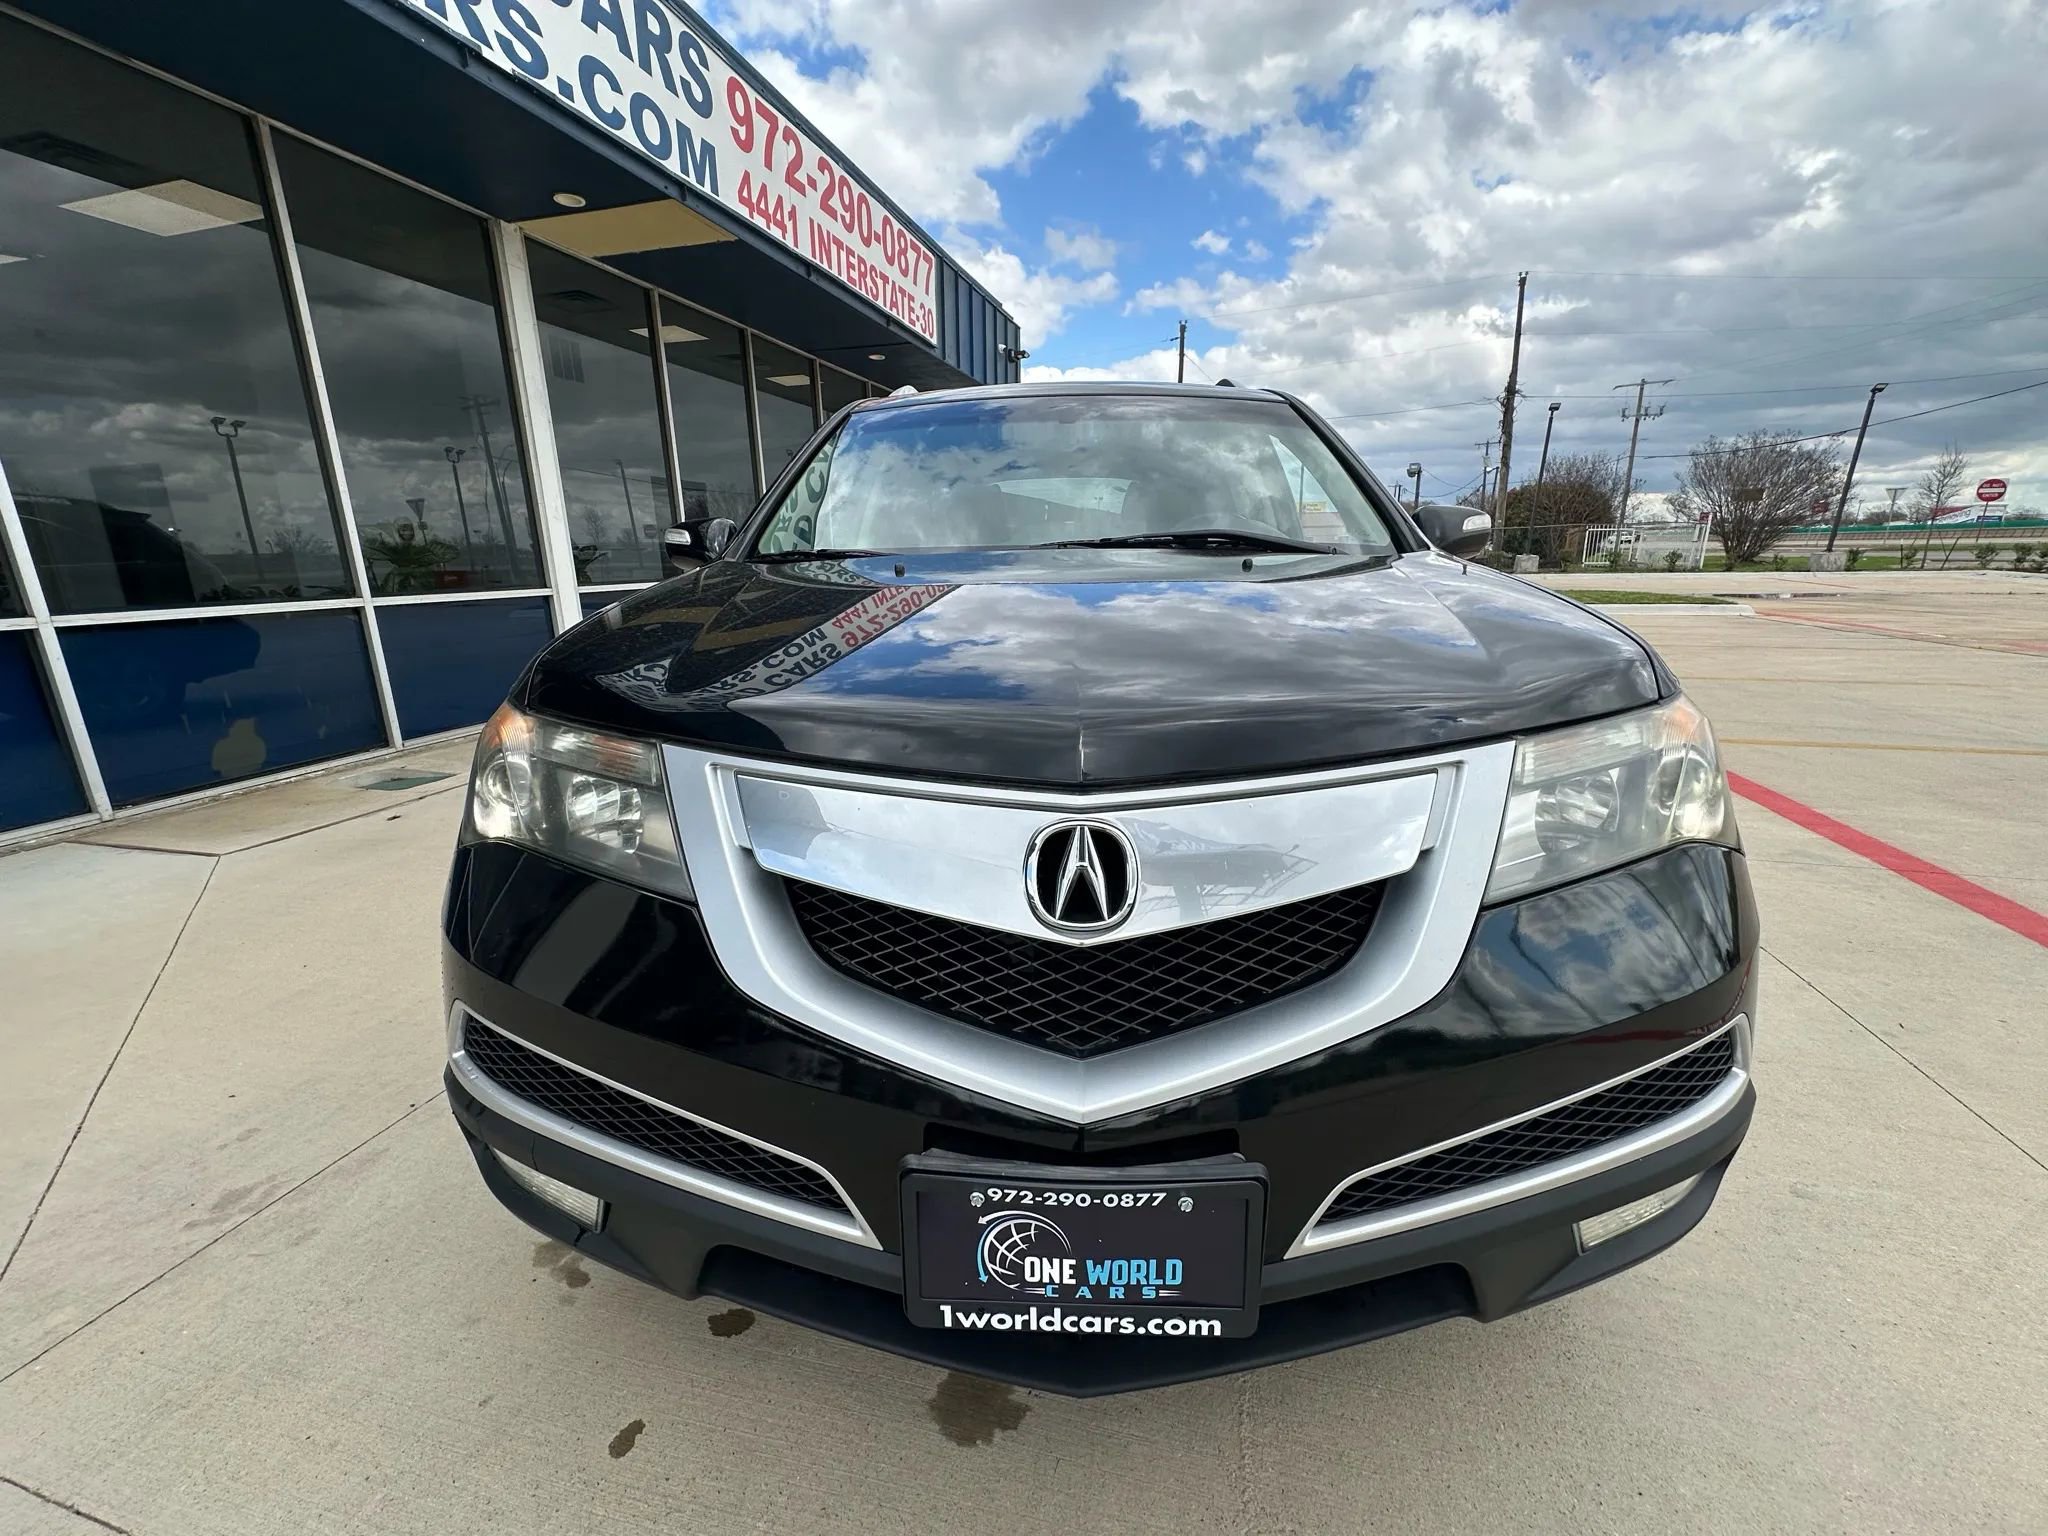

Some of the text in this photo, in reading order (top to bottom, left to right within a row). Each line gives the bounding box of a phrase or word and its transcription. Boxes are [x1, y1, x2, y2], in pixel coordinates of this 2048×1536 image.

[552, 0, 714, 119] ARS
[727, 76, 935, 296] 972-290-0877
[738, 170, 935, 339] 4441 INTERSTATE-30
[986, 1187, 1168, 1208] 972-290-0877
[1024, 1256, 1184, 1287] ONE WORLD
[1044, 1285, 1157, 1300] CARS
[939, 1304, 1222, 1338] 1worldcars.com
